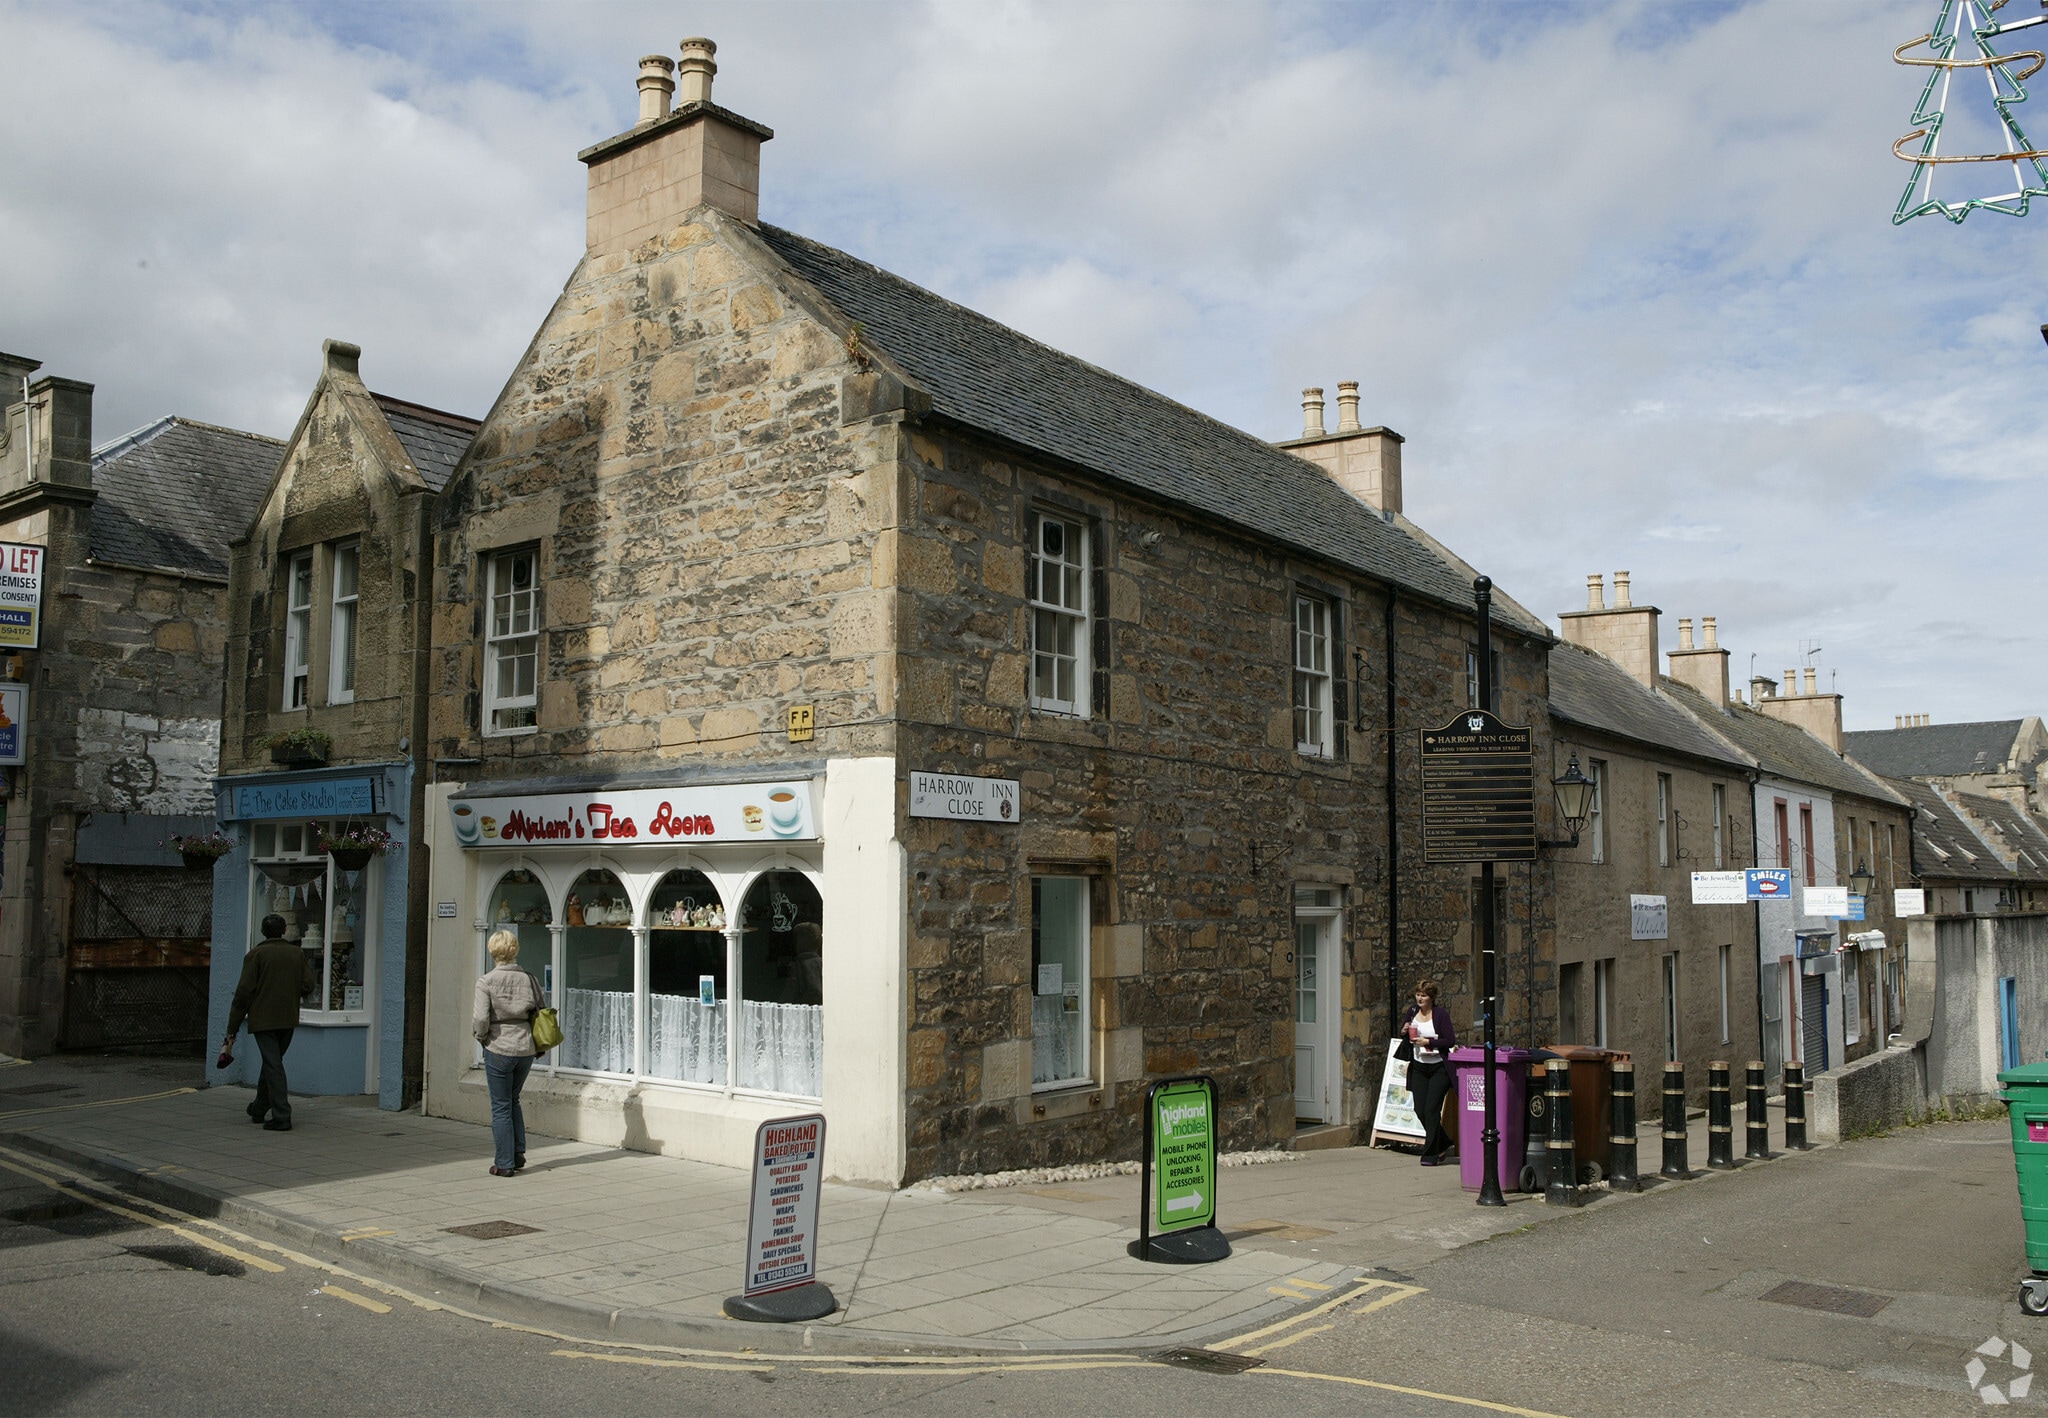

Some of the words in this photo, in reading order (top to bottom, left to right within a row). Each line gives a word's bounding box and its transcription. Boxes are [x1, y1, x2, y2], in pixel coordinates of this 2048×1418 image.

[11, 548, 38, 574] LET
[0, 575, 37, 589] EMISES
[1, 591, 37, 604] CONSENT)
[1, 627, 31, 636] 594172
[1438, 736, 1476, 744] HARROW
[1479, 735, 1496, 743] INN
[918, 777, 974, 796] HARROW
[991, 783, 1013, 799] INN
[253, 791, 271, 813] The
[275, 789, 298, 812] Cake
[301, 787, 334, 810] Studio
[947, 799, 984, 816] CLOSE
[500, 806, 585, 843] Miriam's
[587, 803, 638, 838] Tea
[650, 801, 715, 839] Room
[1160, 1102, 1206, 1127] highland
[765, 1124, 817, 1147] HIGHLAND
[1172, 1120, 1206, 1137] mobiles
[764, 1145, 788, 1158] BAKED
[790, 1141, 816, 1154] POTATO
[1162, 1144, 1184, 1155] MOBILE
[1186, 1141, 1207, 1152] PHONE
[1166, 1153, 1203, 1166] UNLOCKING,
[769, 1166, 790, 1177] QUALITY
[791, 1163, 808, 1172] BAKED
[1170, 1166, 1193, 1177] REPAIRS
[1195, 1165, 1200, 1173] &
[775, 1174, 800, 1185] POTATOES
[1166, 1176, 1204, 1190] ACCESSORIES
[770, 1183, 804, 1196] SANDWICHES
[772, 1194, 800, 1207] BAGUETTES
[776, 1205, 795, 1216] WRAPS
[772, 1215, 796, 1226] TOASTIES
[773, 1225, 794, 1237] PANINIS
[761, 1236, 790, 1249] HOMEMADE
[790, 1233, 805, 1243] SOUP
[763, 1248, 777, 1260] DAILY
[777, 1244, 802, 1256] SPECIALS
[758, 1258, 780, 1271] OUTSIDE
[780, 1253, 805, 1266] CATERING
[767, 1270, 784, 1280] 01343
